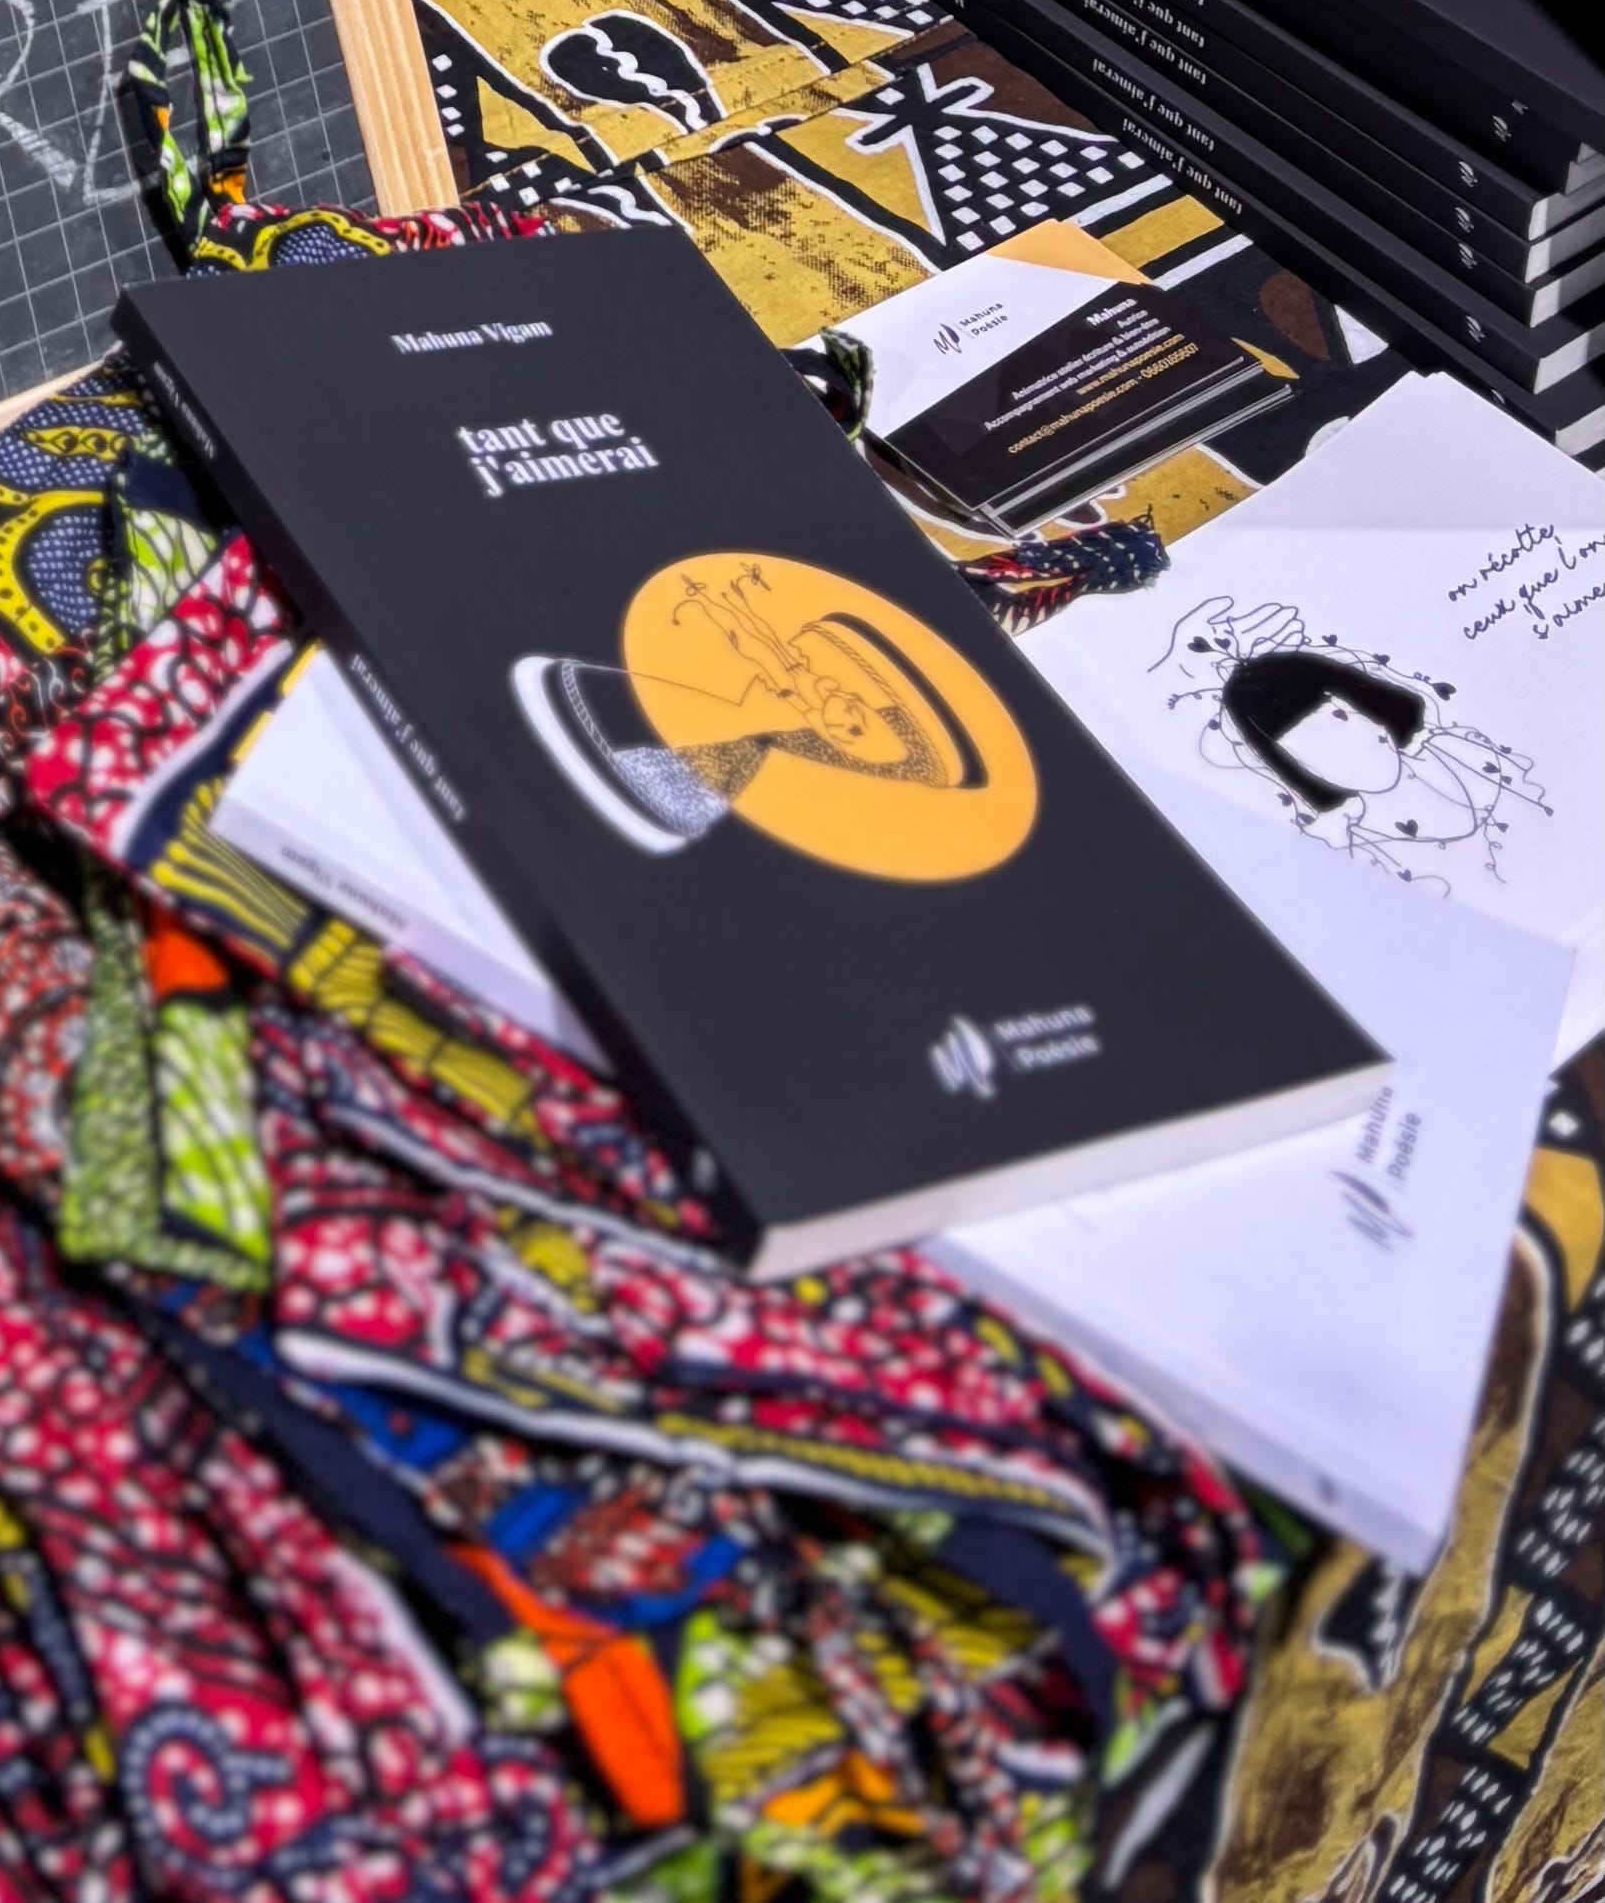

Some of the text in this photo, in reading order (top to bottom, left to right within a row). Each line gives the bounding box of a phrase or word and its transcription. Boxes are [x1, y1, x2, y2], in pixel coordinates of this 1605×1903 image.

[1147, 2, 1174, 25] que
[1176, 21, 1205, 47] tant
[1149, 39, 1175, 62] que
[1177, 58, 1206, 85] tant
[1158, 106, 1184, 128] que
[1186, 125, 1215, 152] tant
[1186, 168, 1212, 190] que
[1214, 187, 1243, 215] tant
[959, 303, 1003, 326] Mahuna
[1086, 298, 1137, 326] Mahuna
[391, 321, 553, 354] Mahuna Vigam
[457, 413, 625, 455] tant que
[470, 436, 659, 497] j'aimerai
[1448, 577, 1478, 602] on
[995, 1007, 1093, 1041] Mahuna
[1355, 1086, 1394, 1164] Mahuna
